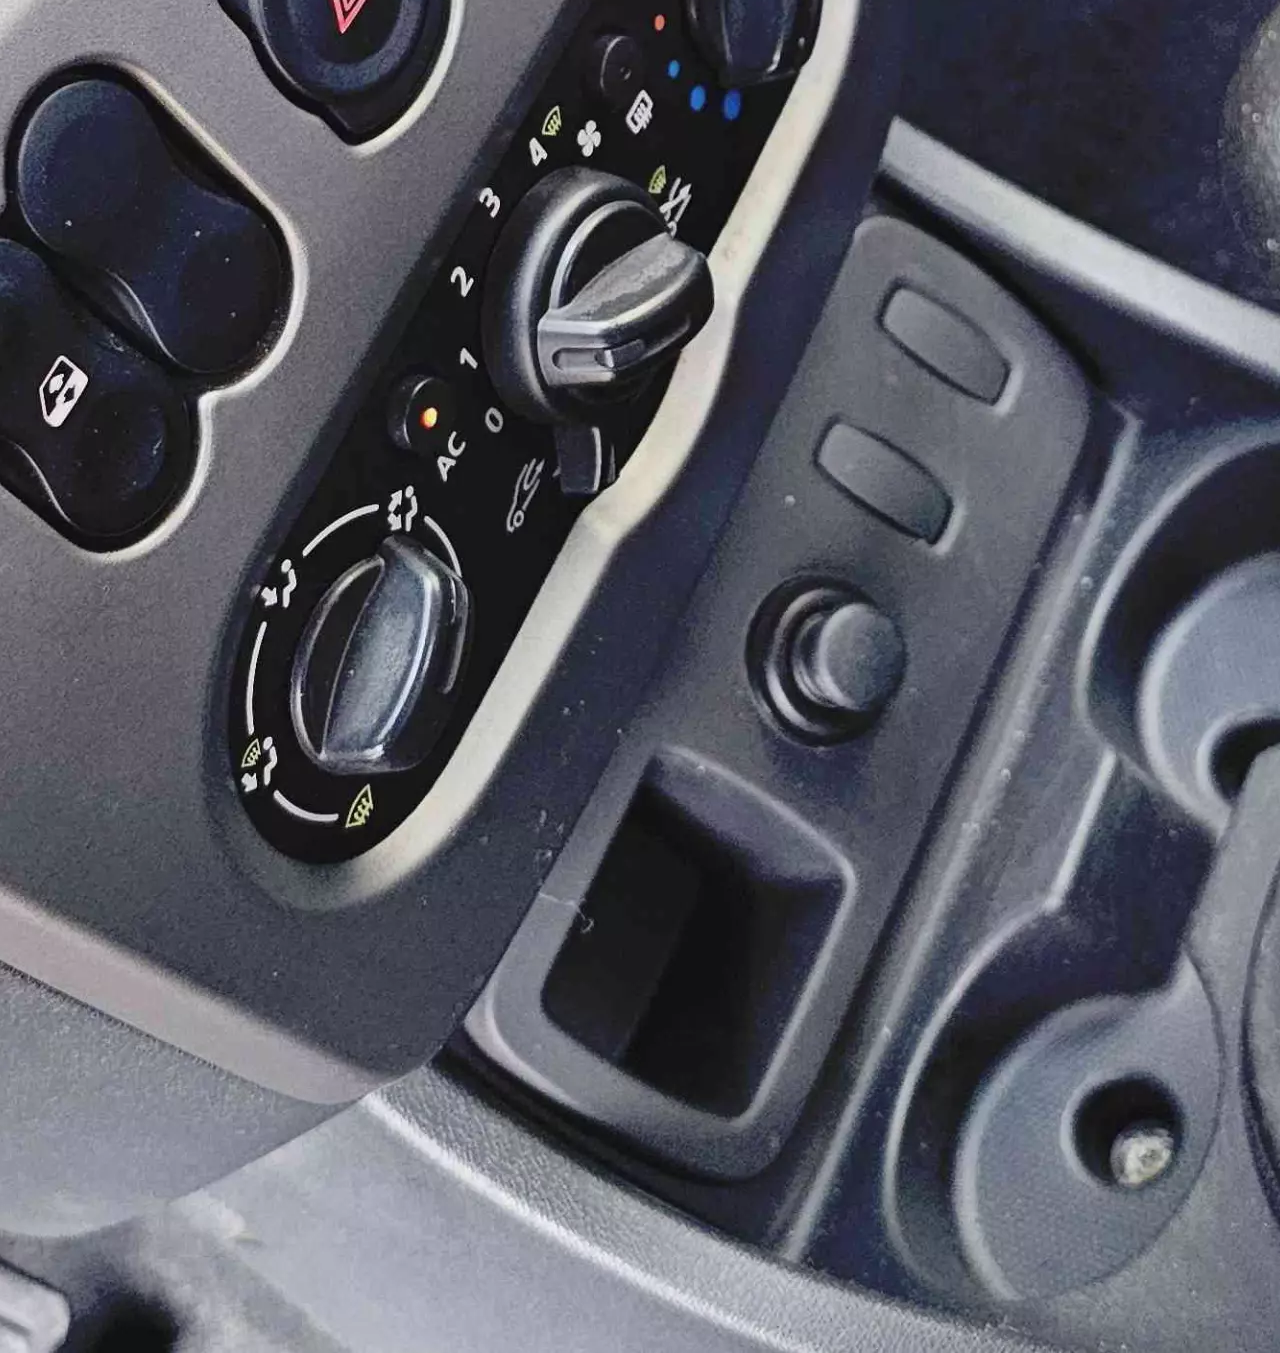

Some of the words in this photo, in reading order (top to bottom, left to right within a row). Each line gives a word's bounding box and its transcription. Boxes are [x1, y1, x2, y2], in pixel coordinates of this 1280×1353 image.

[529, 137, 548, 166] 4
[479, 187, 501, 218] 3
[450, 266, 474, 297] 2
[460, 348, 478, 369] 1
[437, 431, 466, 482] AC
